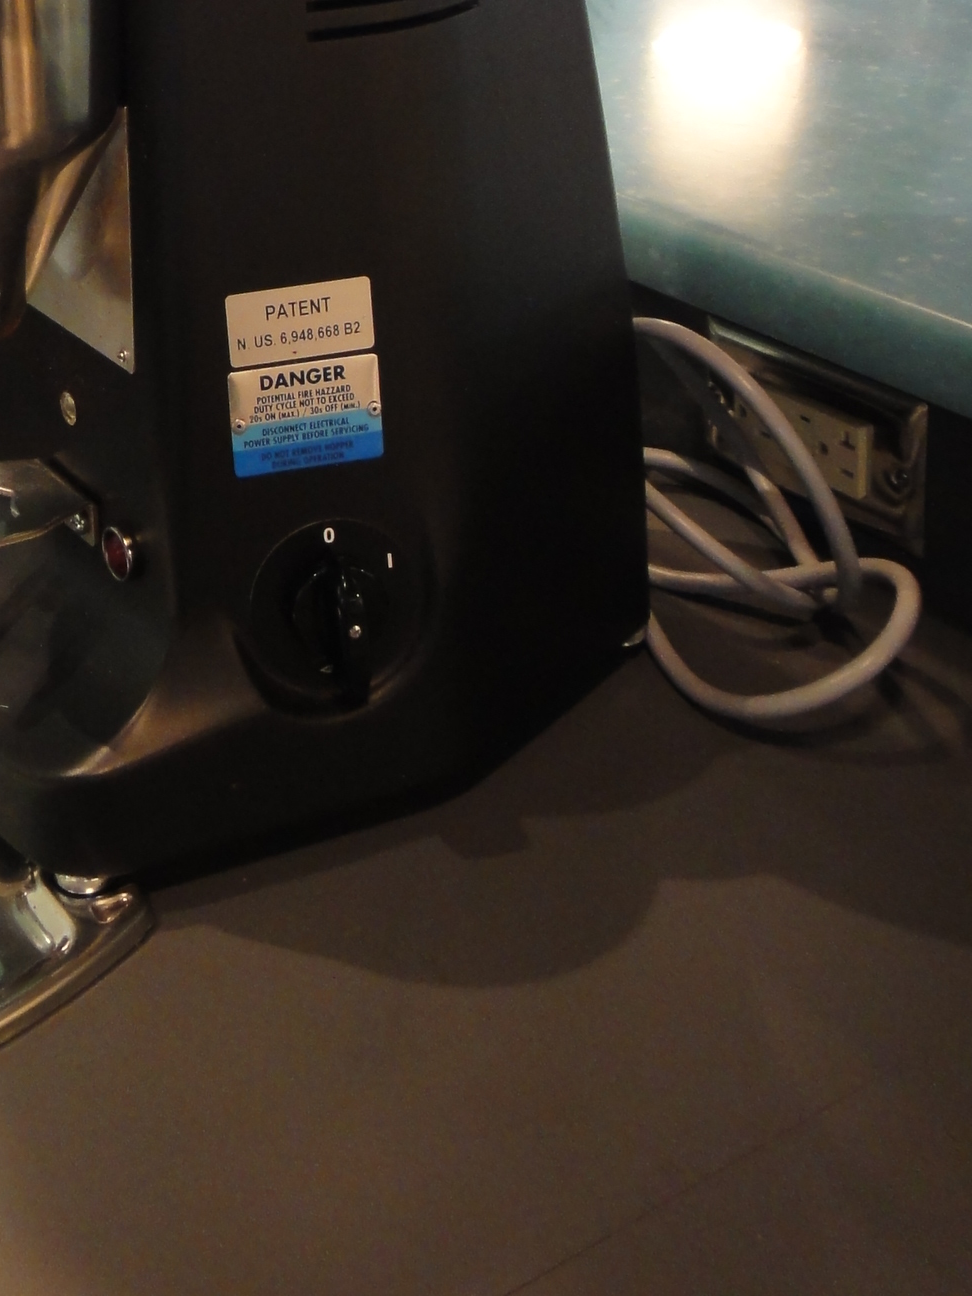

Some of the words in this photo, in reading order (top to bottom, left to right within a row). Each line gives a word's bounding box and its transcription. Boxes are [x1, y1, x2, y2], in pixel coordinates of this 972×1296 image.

[265, 296, 331, 321] PATENT
[254, 335, 277, 347] US.
[280, 324, 340, 344] 6,948,668
[344, 321, 361, 335] B2
[259, 365, 346, 391] DANGER
[254, 404, 273, 414] DUTY
[276, 401, 296, 411] CYCLE
[299, 398, 315, 407] NOT
[316, 397, 327, 405] TO
[328, 392, 355, 403] EXCEED
[256, 392, 295, 405] POTENTIAL
[298, 390, 313, 399] FIRE
[315, 384, 351, 396] HAZZARD
[264, 413, 276, 421] ON
[310, 405, 323, 415] 30s
[325, 404, 338, 412] OFF
[244, 437, 271, 449] POWER
[273, 434, 299, 445] SUPPLY
[302, 430, 329, 441] BEFORE
[331, 423, 370, 436] SERVICING
[262, 422, 307, 437] DISCONNECT
[309, 417, 350, 430] ELECTRICAL
[291, 445, 322, 457] REMOVE
[325, 440, 354, 452] HOPPER
